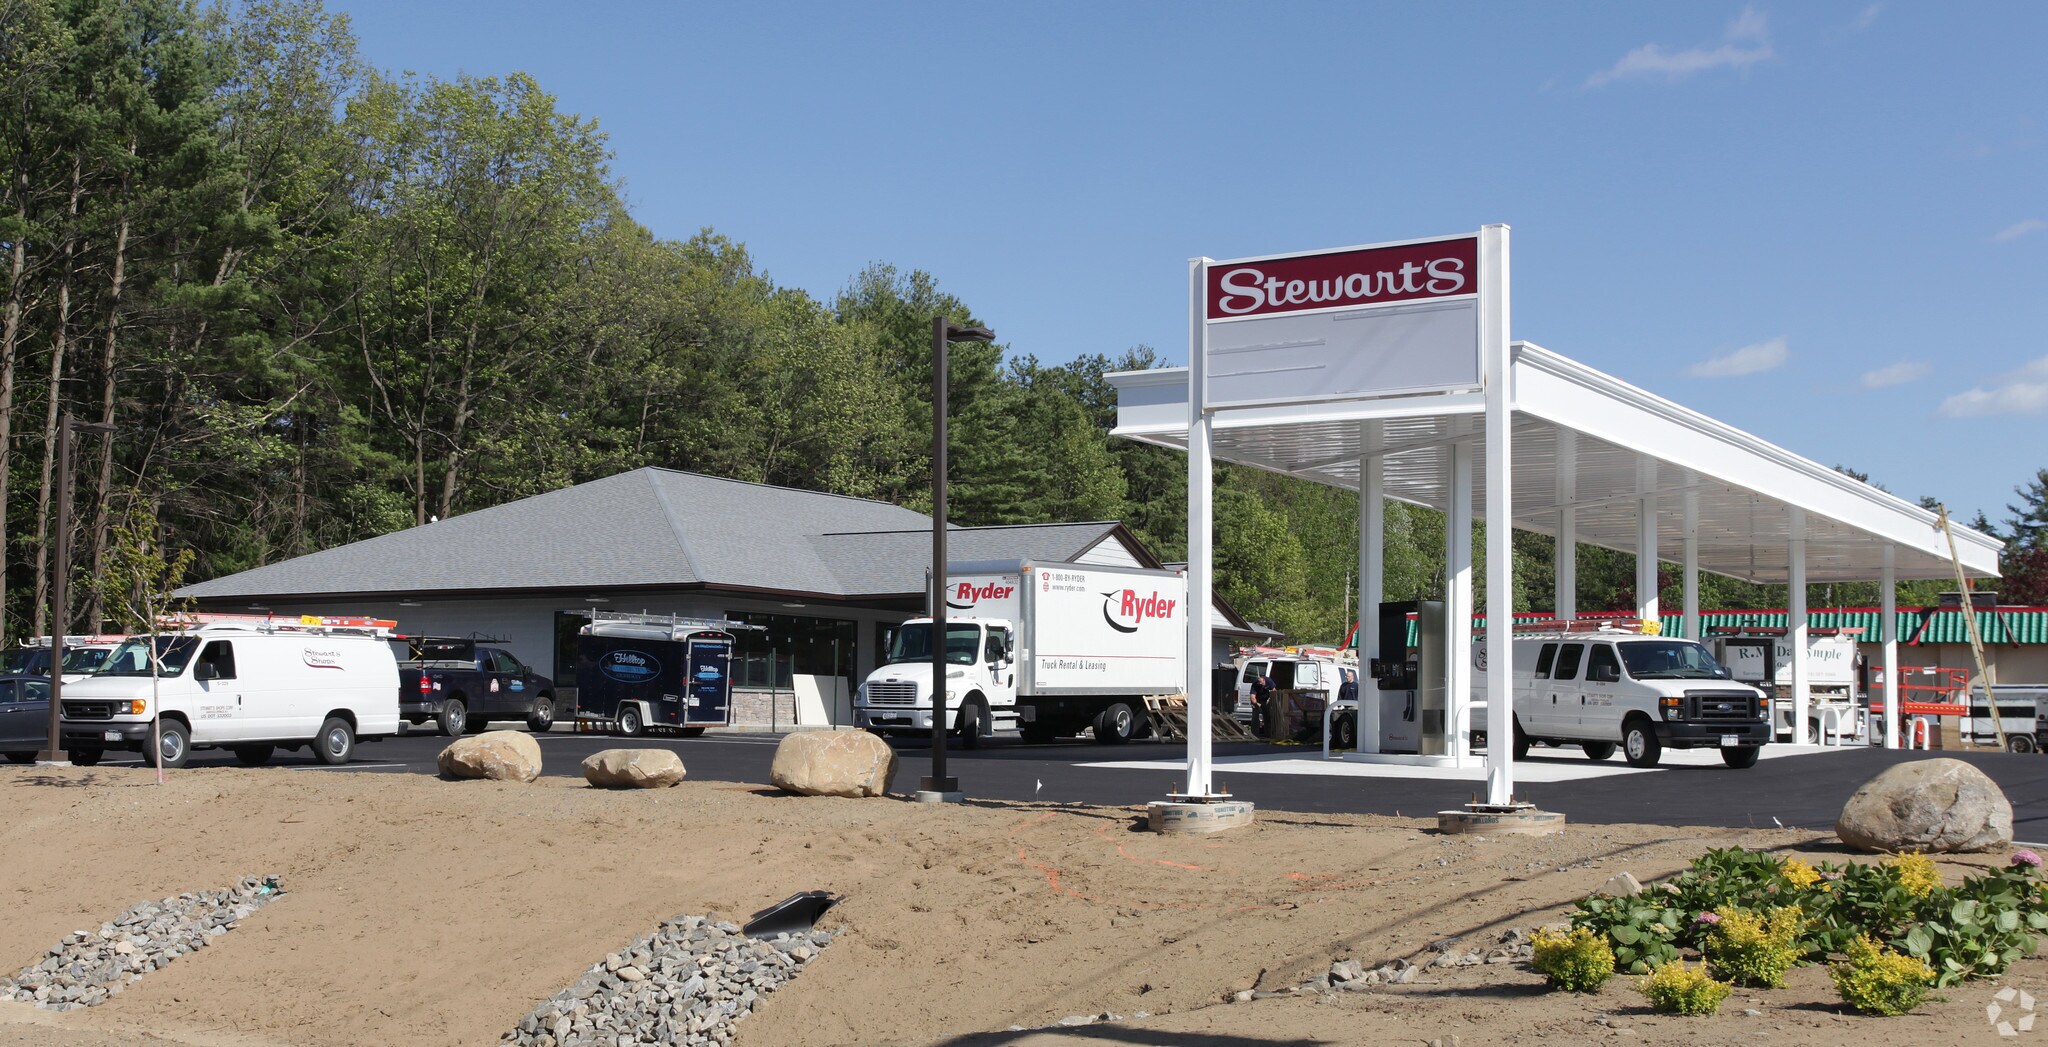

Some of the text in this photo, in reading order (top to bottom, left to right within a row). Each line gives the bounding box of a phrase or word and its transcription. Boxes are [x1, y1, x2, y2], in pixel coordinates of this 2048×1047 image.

[1052, 574, 1085, 582] 1-800-BY-RYDER
[957, 582, 1014, 603] Ryder
[1052, 584, 1085, 592] www.ryder.com
[1121, 589, 1176, 623] Ryder
[614, 653, 646, 666] Hilltop
[1042, 659, 1106, 672] Truck Rental & Leasing
